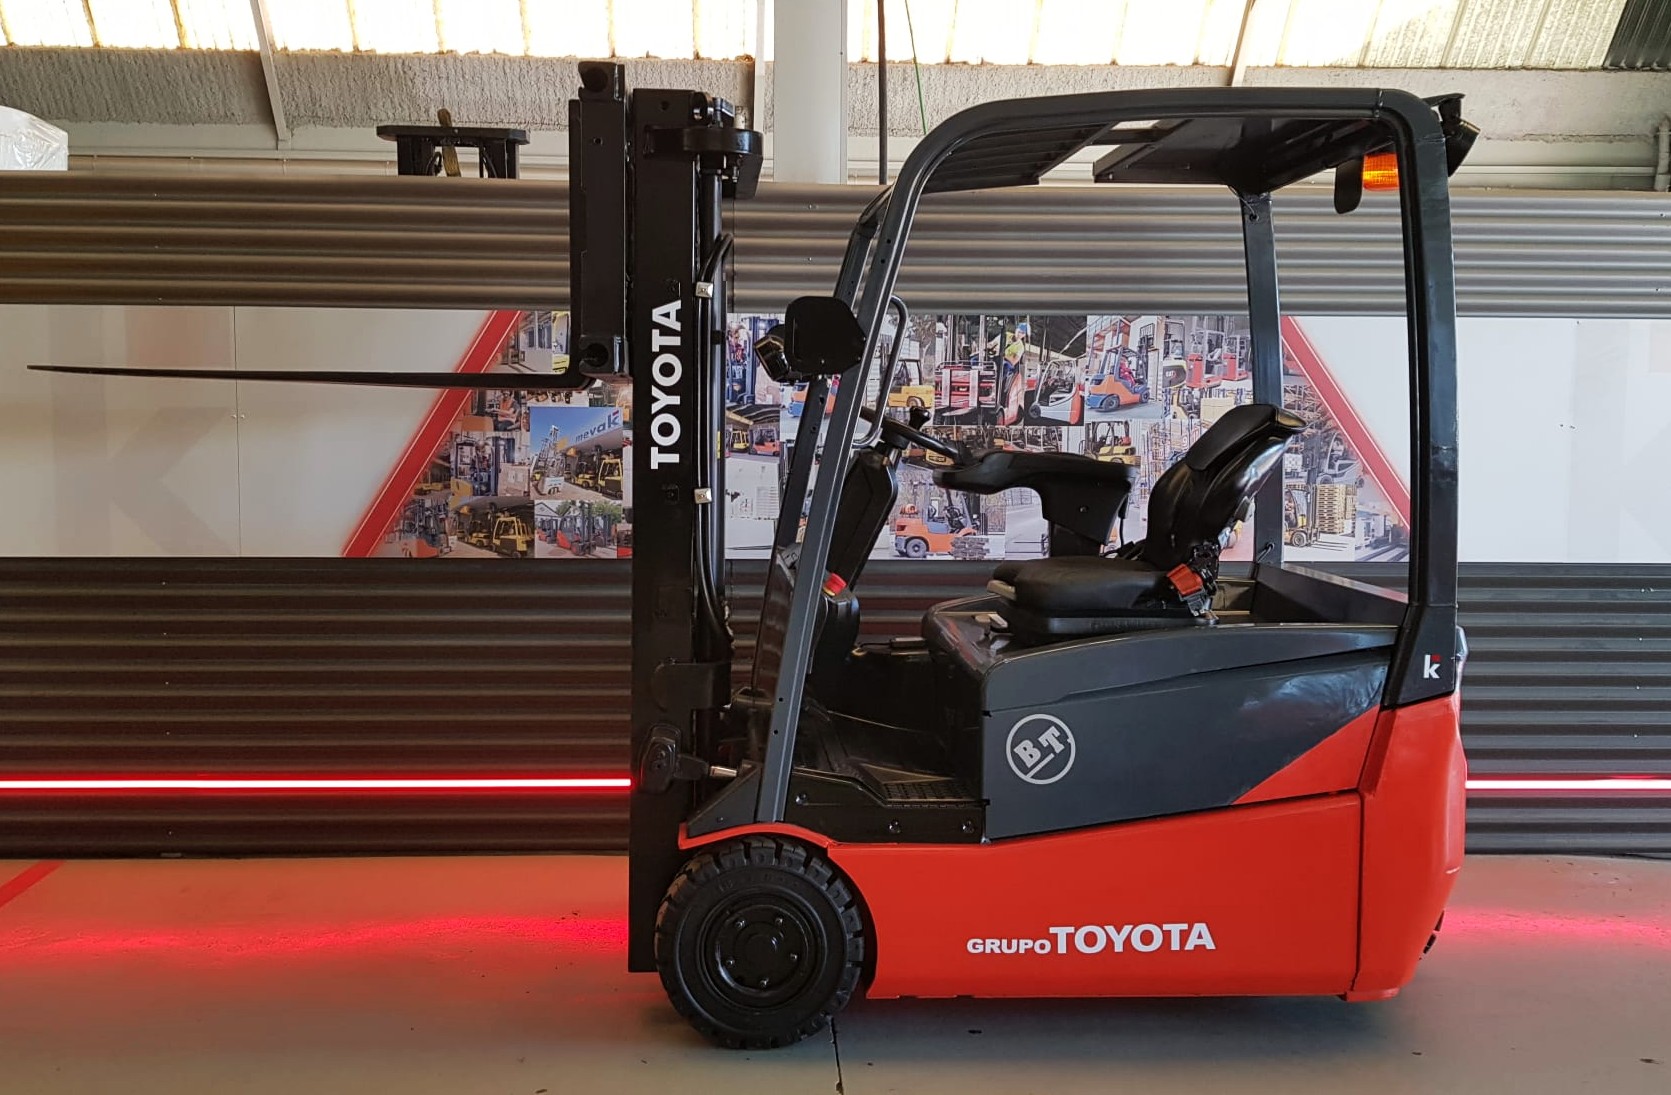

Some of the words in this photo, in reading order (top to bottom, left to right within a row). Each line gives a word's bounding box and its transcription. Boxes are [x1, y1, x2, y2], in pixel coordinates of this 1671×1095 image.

[650, 299, 683, 470] TOYOTA
[575, 410, 620, 442] mevak
[966, 938, 1051, 955] GRUPO
[1049, 922, 1217, 955] TOYOTA
